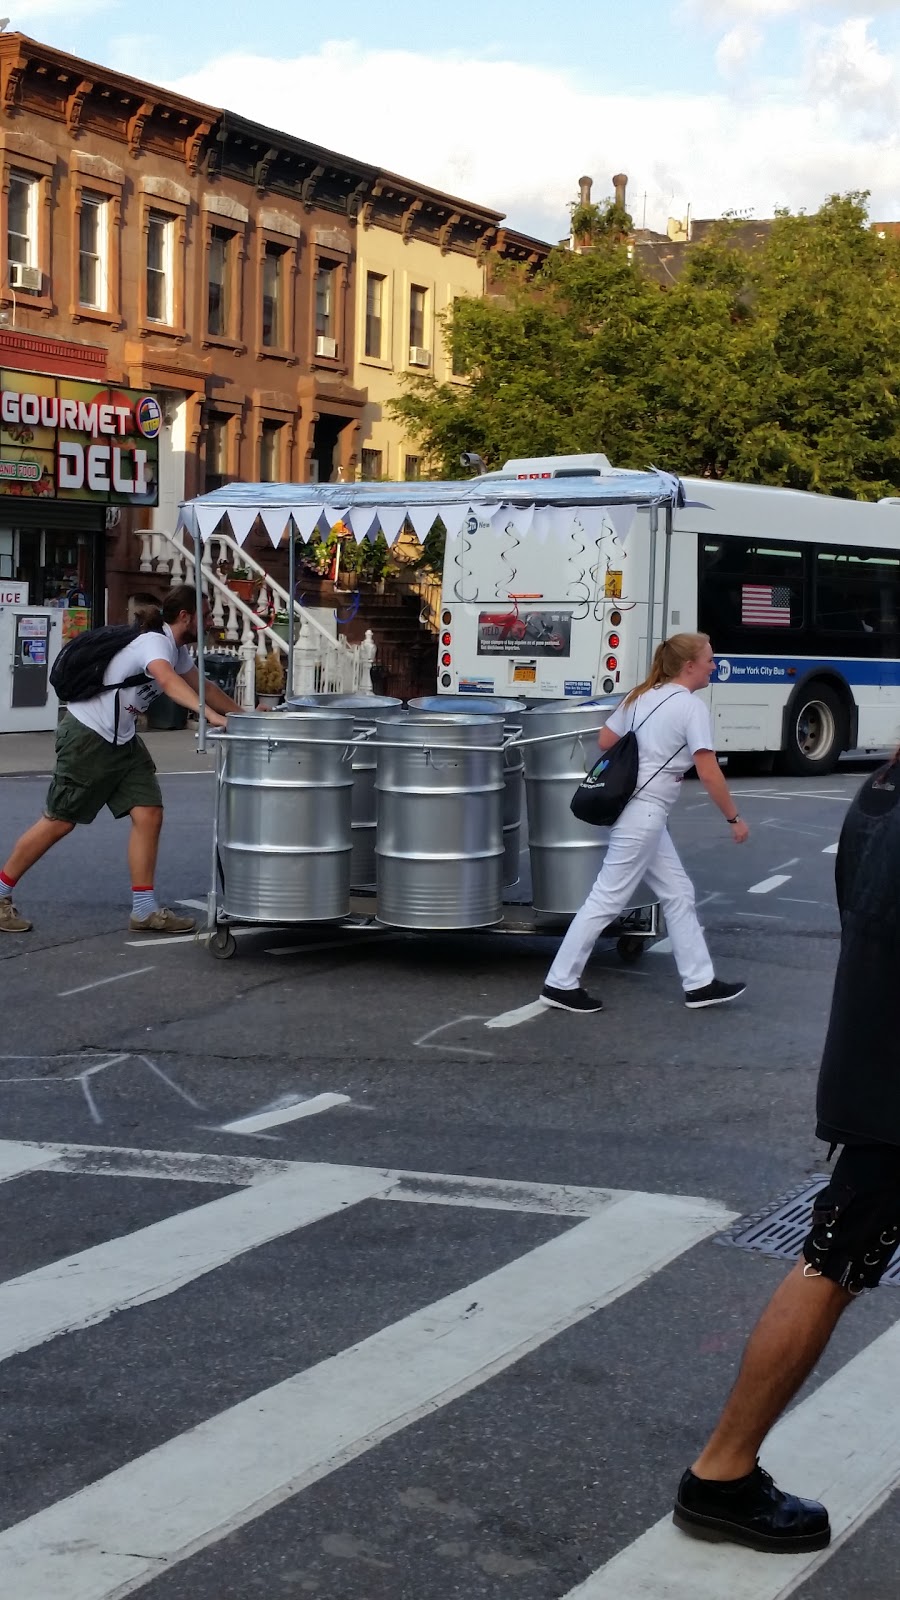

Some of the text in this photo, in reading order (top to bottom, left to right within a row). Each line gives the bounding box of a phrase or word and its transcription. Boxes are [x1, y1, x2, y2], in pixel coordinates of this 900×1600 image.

[2, 391, 131, 438] GOURMET
[17, 464, 38, 479] FOOD
[58, 441, 148, 494] DELI
[1, 592, 21, 603] ICE
[482, 626, 500, 636] YIELD
[732, 666, 745, 675] New
[746, 666, 759, 675] York
[760, 667, 772, 676] City
[773, 667, 785, 676] Bus
